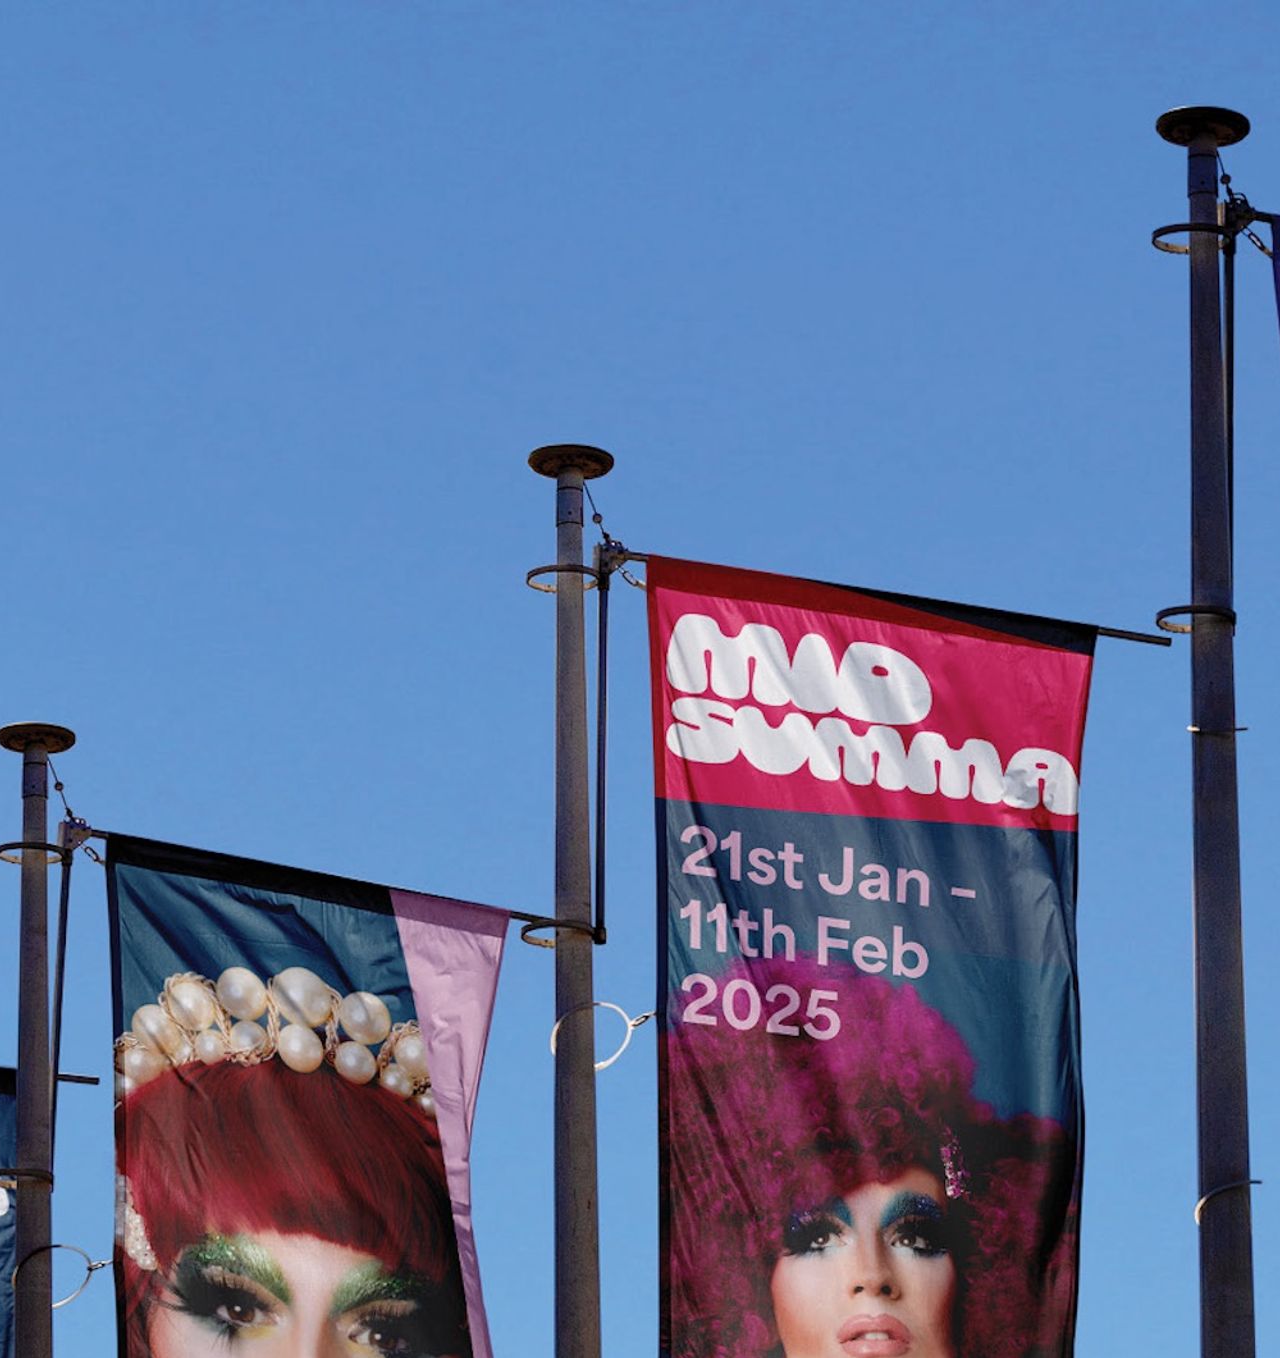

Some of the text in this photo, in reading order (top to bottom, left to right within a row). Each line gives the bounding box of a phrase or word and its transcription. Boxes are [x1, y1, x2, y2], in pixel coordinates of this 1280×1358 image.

[666, 613, 932, 725] MID
[666, 697, 1079, 816] SUMMA
[680, 825, 803, 890] 21st
[818, 847, 930, 907] Jan
[680, 899, 929, 979] 11th Feb
[681, 974, 841, 1041] 2025
